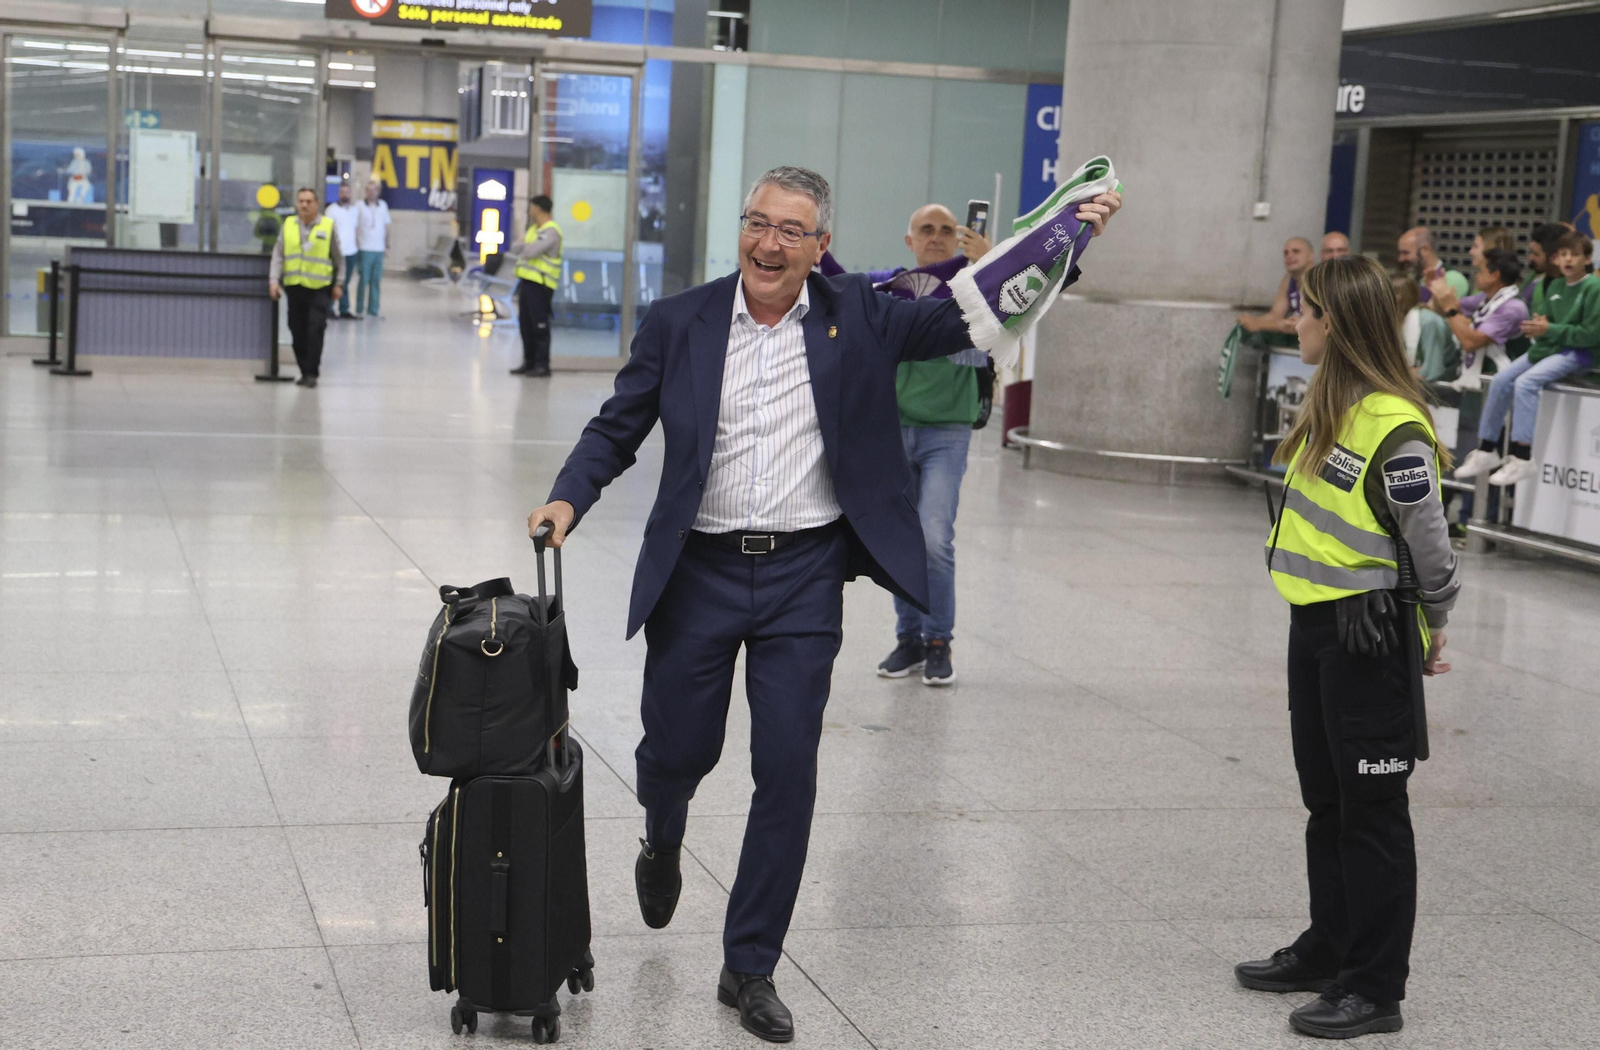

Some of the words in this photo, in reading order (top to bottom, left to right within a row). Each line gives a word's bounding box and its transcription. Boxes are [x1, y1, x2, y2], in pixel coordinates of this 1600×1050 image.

[431, 9, 489, 25] personal
[491, 14, 562, 31] autorizado
[509, 3, 532, 15] only
[1336, 85, 1366, 113] re
[371, 144, 458, 191] ATM
[1329, 453, 1362, 476] ablisa
[1336, 471, 1355, 484] GRUPO
[1385, 470, 1428, 484] Trablisa
[1542, 463, 1598, 493] ENGEL
